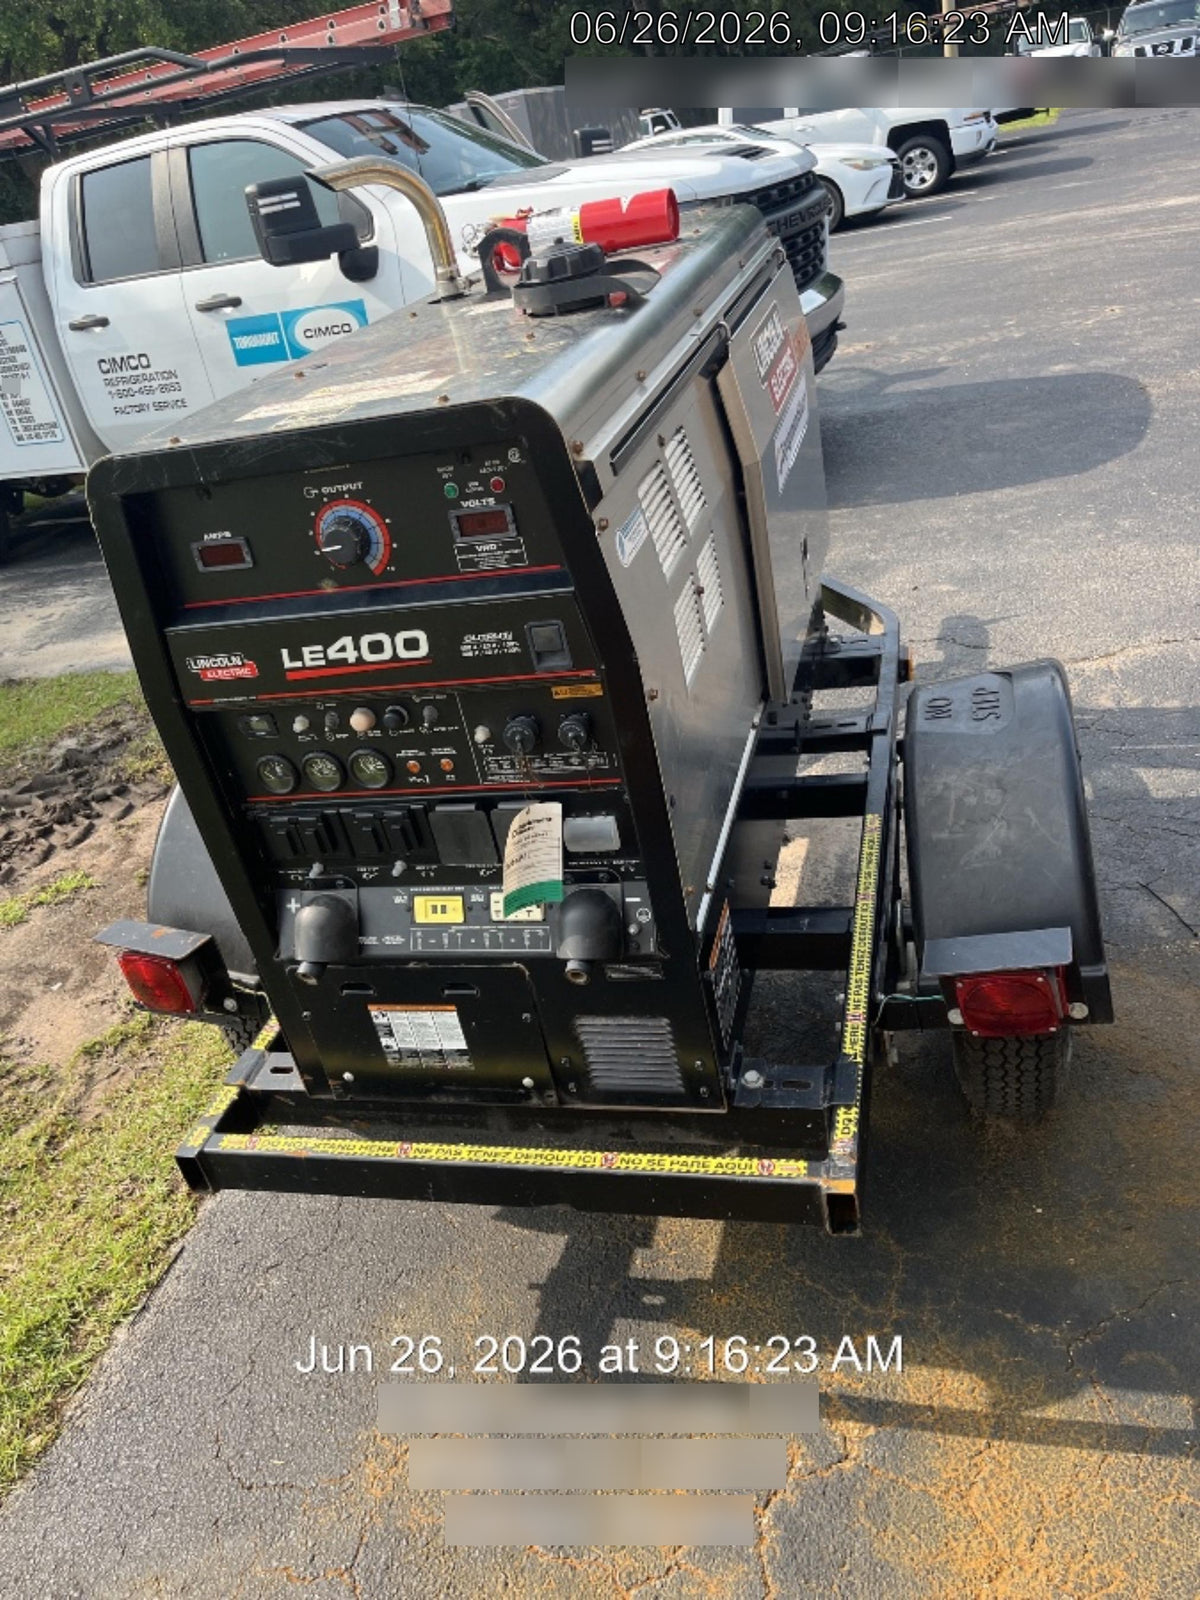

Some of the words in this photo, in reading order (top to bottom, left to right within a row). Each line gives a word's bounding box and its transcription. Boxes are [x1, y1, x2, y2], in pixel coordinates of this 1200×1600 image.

[303, 322, 353, 339] CIMCO
[97, 353, 151, 374] CIMCO
[321, 481, 364, 494] OUTPUT
[460, 497, 496, 508] VOLTS
[280, 629, 430, 670] LE400
[191, 655, 243, 670] LINCOLN
[206, 667, 252, 678] ELECTRIC
[924, 696, 954, 721] NO
[971, 687, 1002, 722] STEP
[577, 1154, 597, 1164] ICI
[619, 1157, 643, 1166] NO
[646, 1158, 666, 1167] SE
[669, 1159, 711, 1169] PARE
[714, 1160, 753, 1170] AQUI
